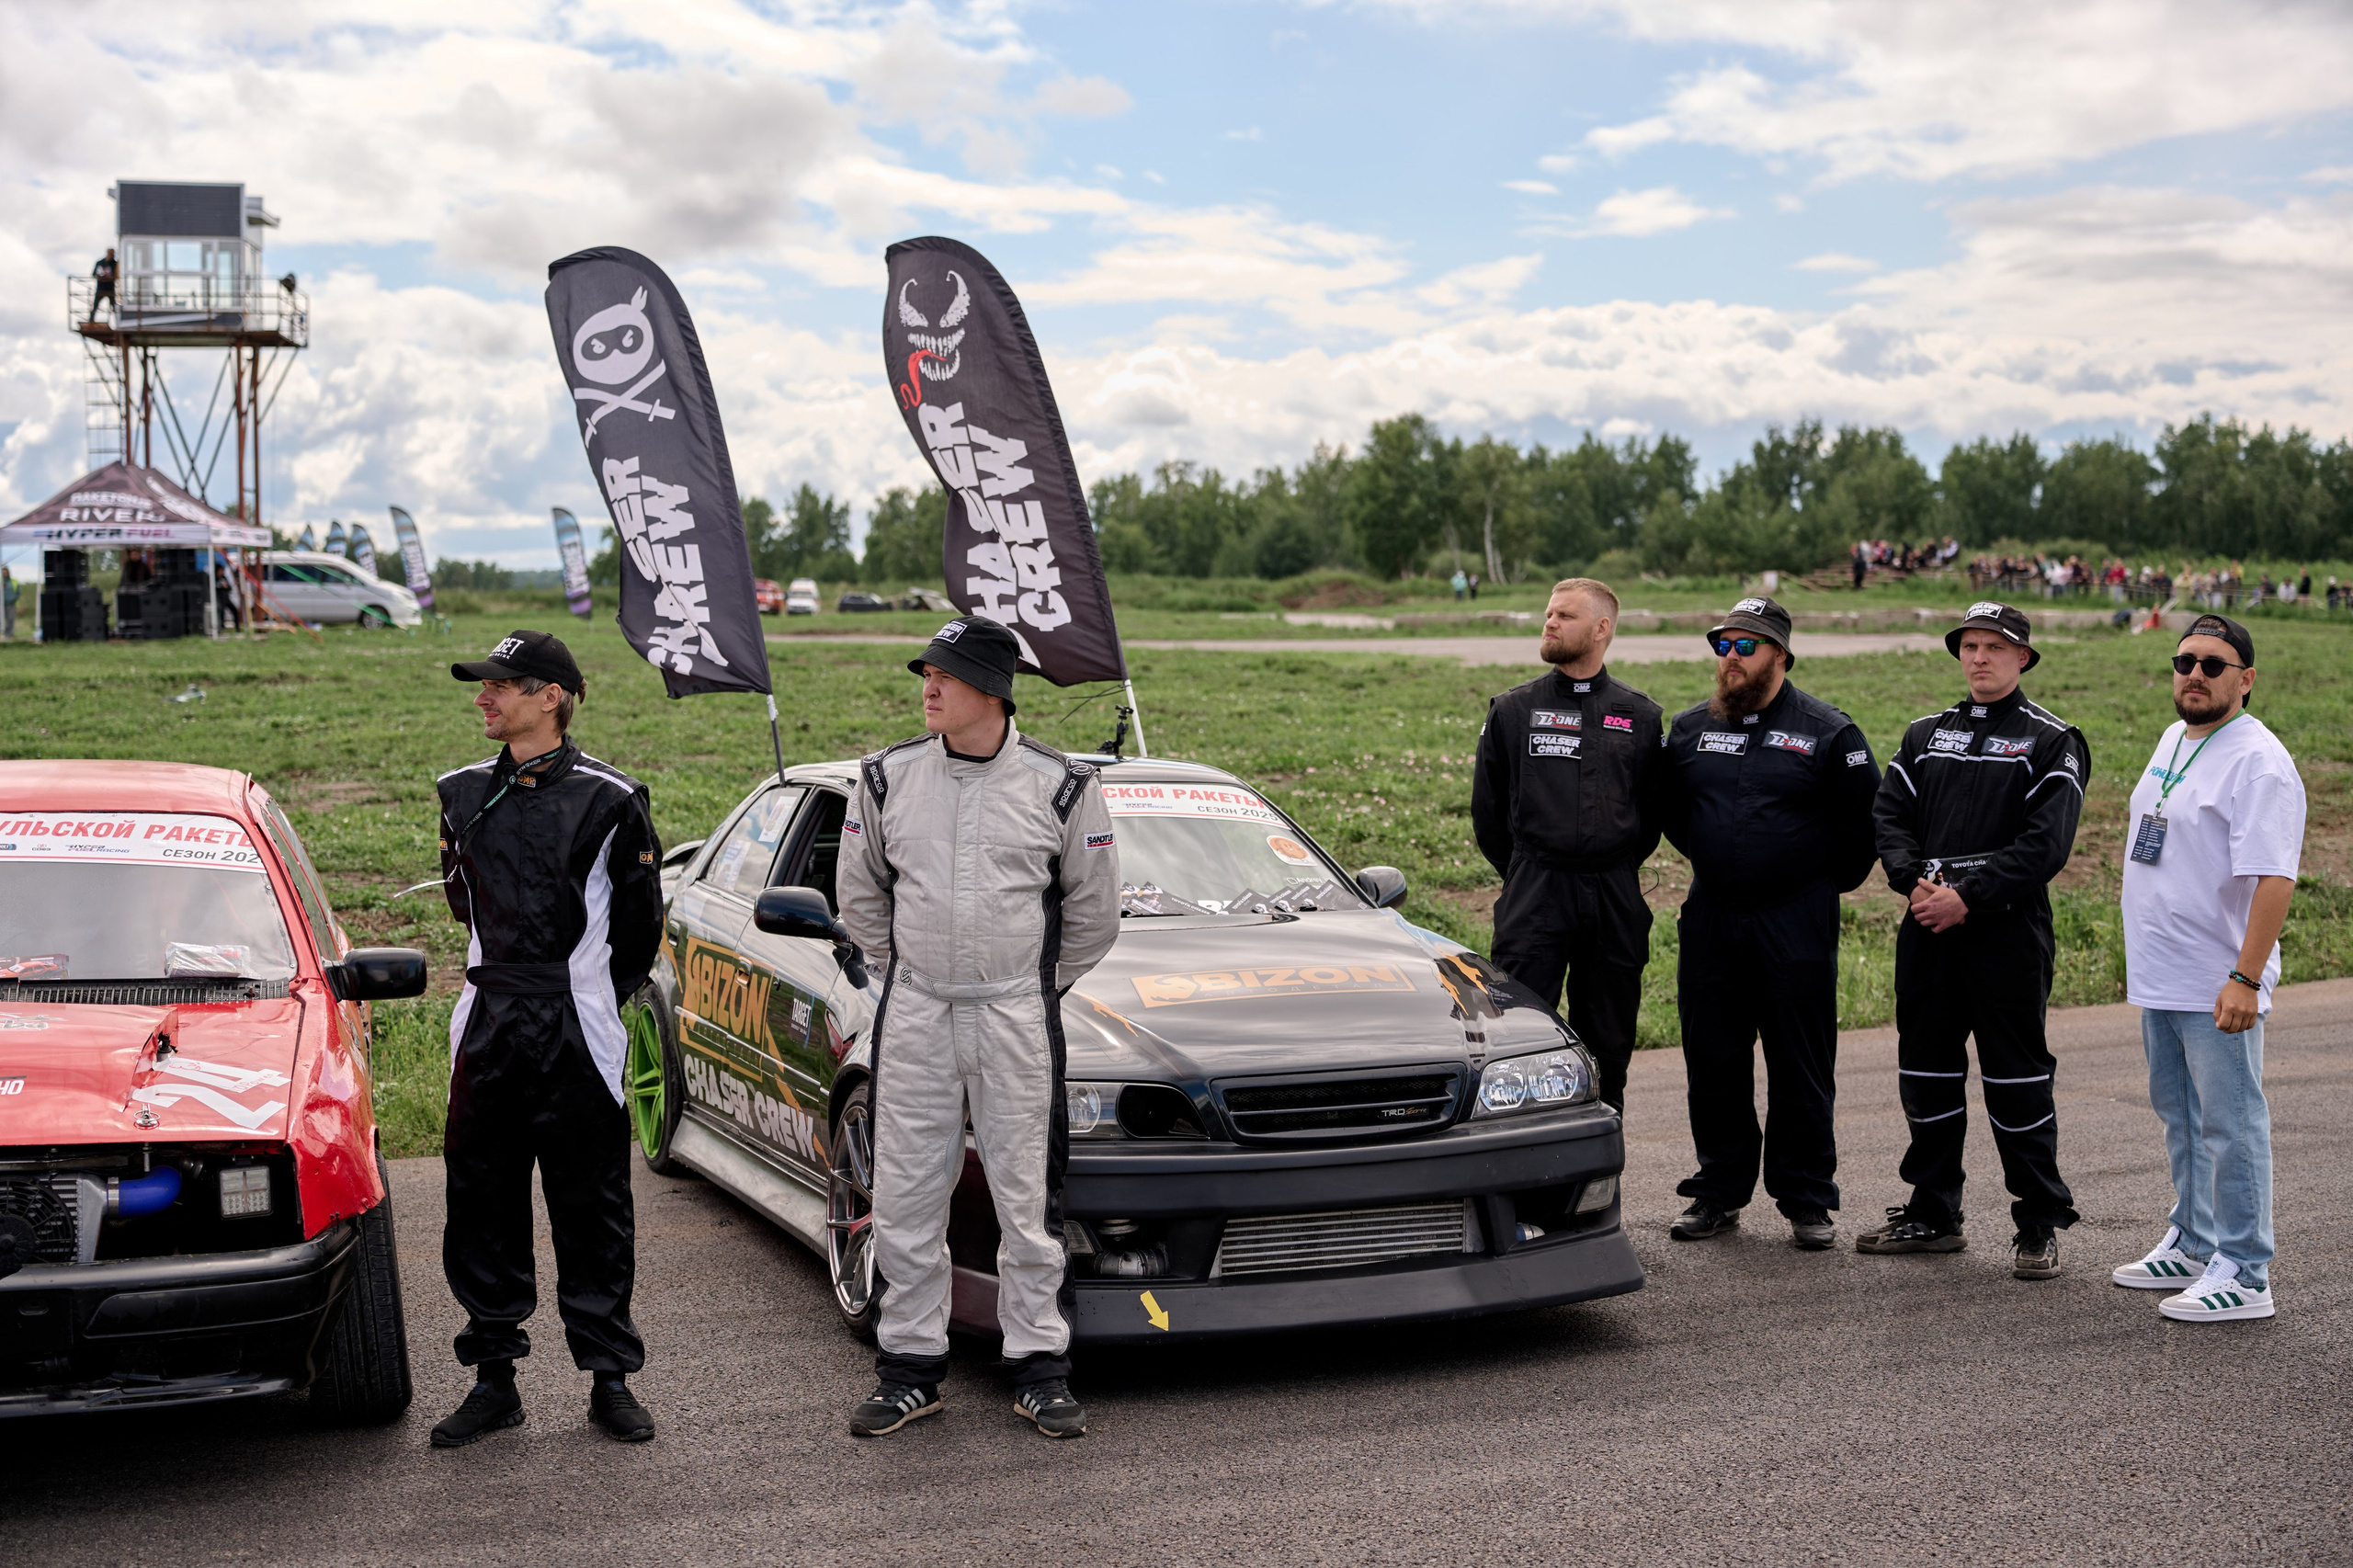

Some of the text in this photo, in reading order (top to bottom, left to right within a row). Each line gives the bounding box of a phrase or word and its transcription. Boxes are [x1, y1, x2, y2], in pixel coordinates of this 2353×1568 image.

[968, 424, 1072, 631] CREW
[1604, 715, 1633, 729] RDS
[1743, 715, 1759, 723] OMP
[1532, 735, 1581, 748] CHASER
[1703, 734, 1746, 745] CHASER
[1537, 744, 1574, 756] CREW
[1705, 742, 1740, 753] CREW
[1846, 752, 1868, 766] OMP
[517, 775, 535, 787] OMP
[870, 766, 884, 793] sparco
[1058, 778, 1077, 808] sparco
[1172, 789, 1266, 809] РАКЕТЫ
[1197, 805, 1279, 822] СЕЗОН 2025
[162, 848, 217, 860] СЕЗОН
[1951, 861, 1973, 869] TOYOTA
[1192, 966, 1398, 992] BIZON
[1203, 983, 1404, 998] АВТОДЕТАЛЬ
[699, 956, 768, 1044] BIZON
[684, 1053, 817, 1163] CHASER CREW
[1381, 1108, 1405, 1117] TRD
